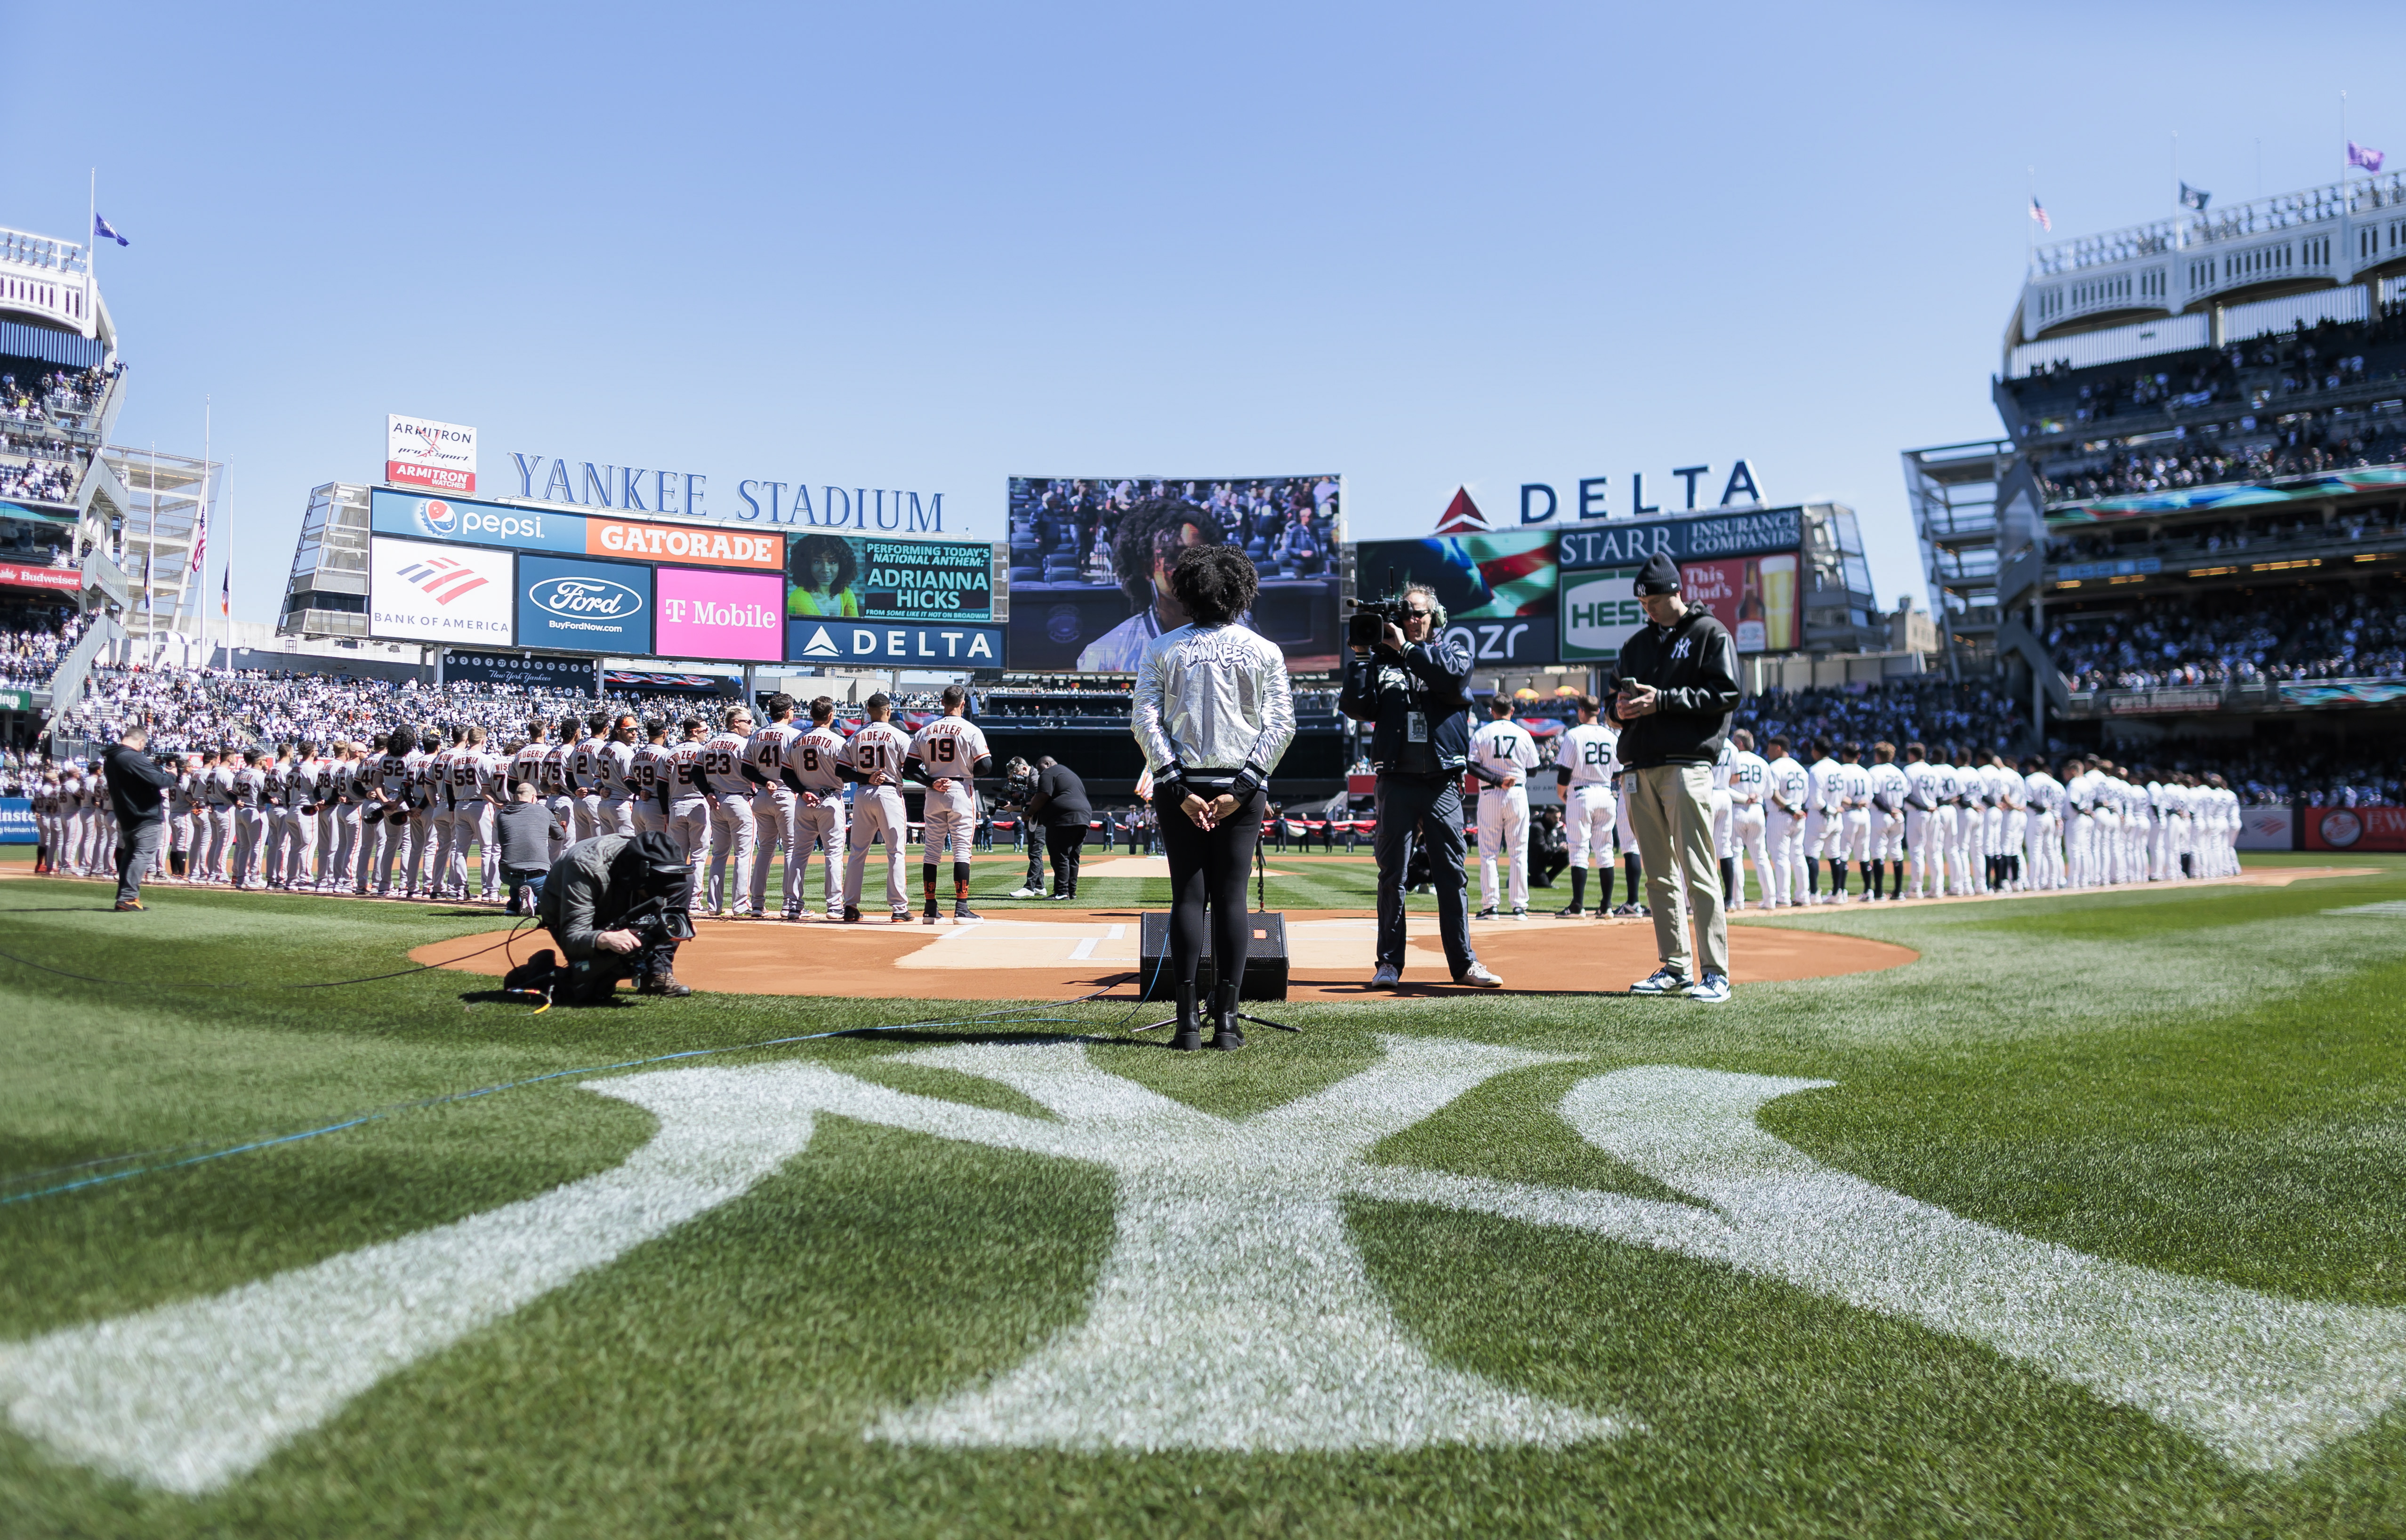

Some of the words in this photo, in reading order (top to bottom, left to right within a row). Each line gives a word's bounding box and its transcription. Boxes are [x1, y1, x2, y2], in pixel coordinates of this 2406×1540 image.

[394, 423, 471, 443] ARMITRON
[396, 465, 468, 483] ARMITRON
[432, 479, 466, 489] WATCHES
[507, 452, 708, 517] YANKEE
[736, 479, 945, 533] STADIUM
[1521, 458, 1766, 524] DELTA
[462, 512, 542, 539] pepsi
[1691, 510, 1801, 537] INSURANCE
[601, 525, 772, 562] GATORADE
[867, 543, 941, 555] PERFORMING
[943, 547, 990, 558] TODAY'S
[1561, 526, 1678, 564] STARR
[1691, 529, 1801, 554] COMPANIES
[873, 553, 929, 565] NATIONAL
[932, 556, 985, 567] ANTHEM:
[20, 571, 79, 585] Budweiser
[867, 568, 989, 590] ADRIANNA
[1684, 566, 1725, 583] This
[549, 581, 623, 614] Ford
[897, 589, 960, 609] HICKS
[1686, 583, 1732, 601] Bud's
[374, 612, 415, 625] BANK
[420, 617, 439, 626] OF
[443, 618, 509, 632] AMERICA
[666, 599, 685, 623] T
[692, 601, 776, 629] Mobile
[549, 620, 622, 633] BuyFordNow.com
[853, 629, 993, 658] DELTA
[1178, 637, 1255, 669] YANKEES
[488, 670, 506, 678] New
[506, 671, 523, 682] York
[523, 673, 551, 683] Yankees
[756, 731, 784, 742] FLORES
[879, 730, 892, 744] JR.
[925, 724, 962, 737] KAPLER
[576, 744, 595, 754] SABOL
[792, 736, 832, 749] CONFORTO
[928, 737, 956, 763] 19
[1493, 735, 1517, 759] 17
[519, 750, 545, 760] ROGERS
[634, 753, 658, 763] ESTRADA
[758, 745, 780, 768] 41
[803, 748, 819, 771] 8
[859, 745, 885, 769] 31
[1585, 742, 1611, 765] 26
[383, 760, 405, 777] 52
[519, 761, 539, 780] 71
[544, 761, 562, 781] 75
[577, 755, 588, 775] 2
[705, 753, 732, 775] 23
[1740, 764, 1762, 783] 28
[288, 775, 301, 791] 34
[454, 768, 476, 787] 59
[634, 765, 655, 786] 39
[1787, 772, 1804, 790] 25
[236, 782, 250, 797] 32
[264, 778, 279, 793] 33
[1854, 779, 1866, 796] 11
